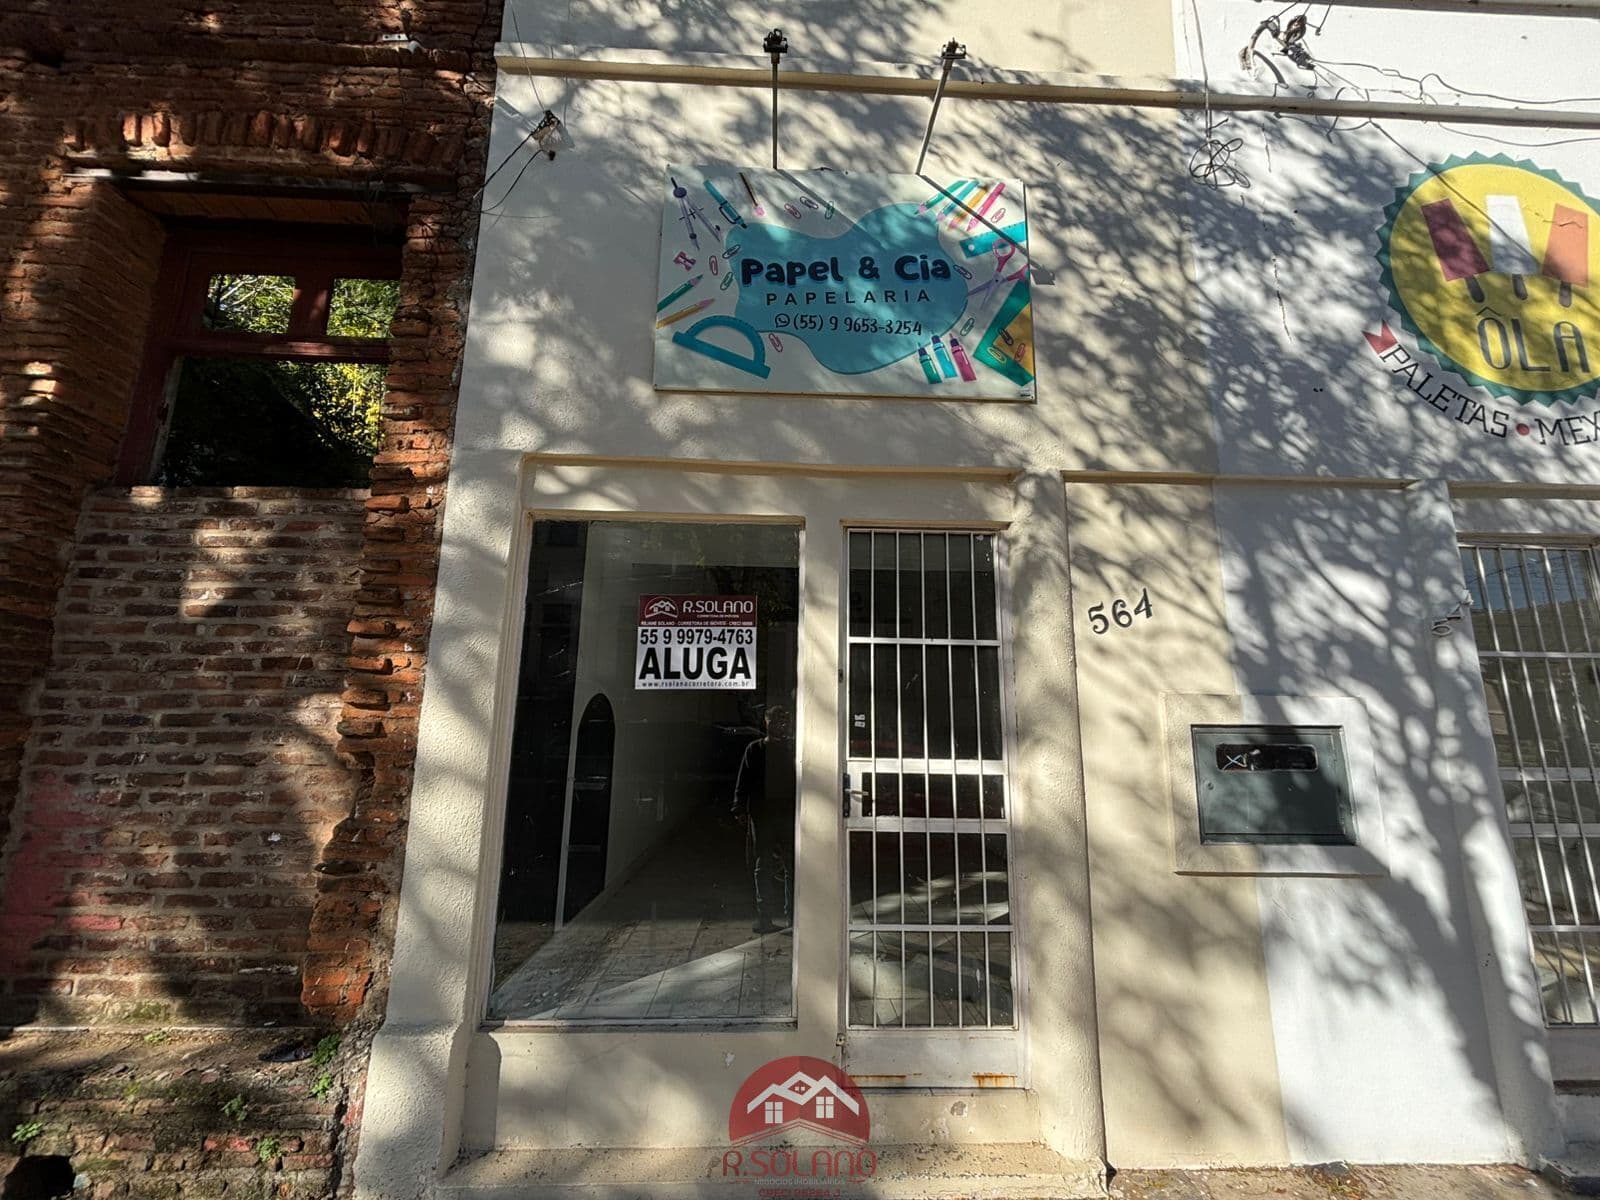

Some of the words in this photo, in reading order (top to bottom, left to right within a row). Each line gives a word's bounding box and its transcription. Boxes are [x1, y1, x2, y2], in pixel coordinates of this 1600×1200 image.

[740, 256, 844, 286] Papel
[858, 256, 880, 280] &
[894, 254, 950, 281] Cia
[766, 289, 930, 306] PAPELARIA
[793, 314, 824, 331] (55)
[829, 316, 838, 330] 9
[844, 316, 922, 336] 9653-3254
[1476, 306, 1591, 373] ÔLA
[1379, 344, 1510, 438] PALETAS
[682, 600, 753, 613] R.SOLANO
[1087, 588, 1153, 634] 564
[640, 629, 658, 645] 55
[663, 629, 672, 645] 9
[677, 629, 753, 645] 9979-4763
[638, 646, 752, 680] ALUGA
